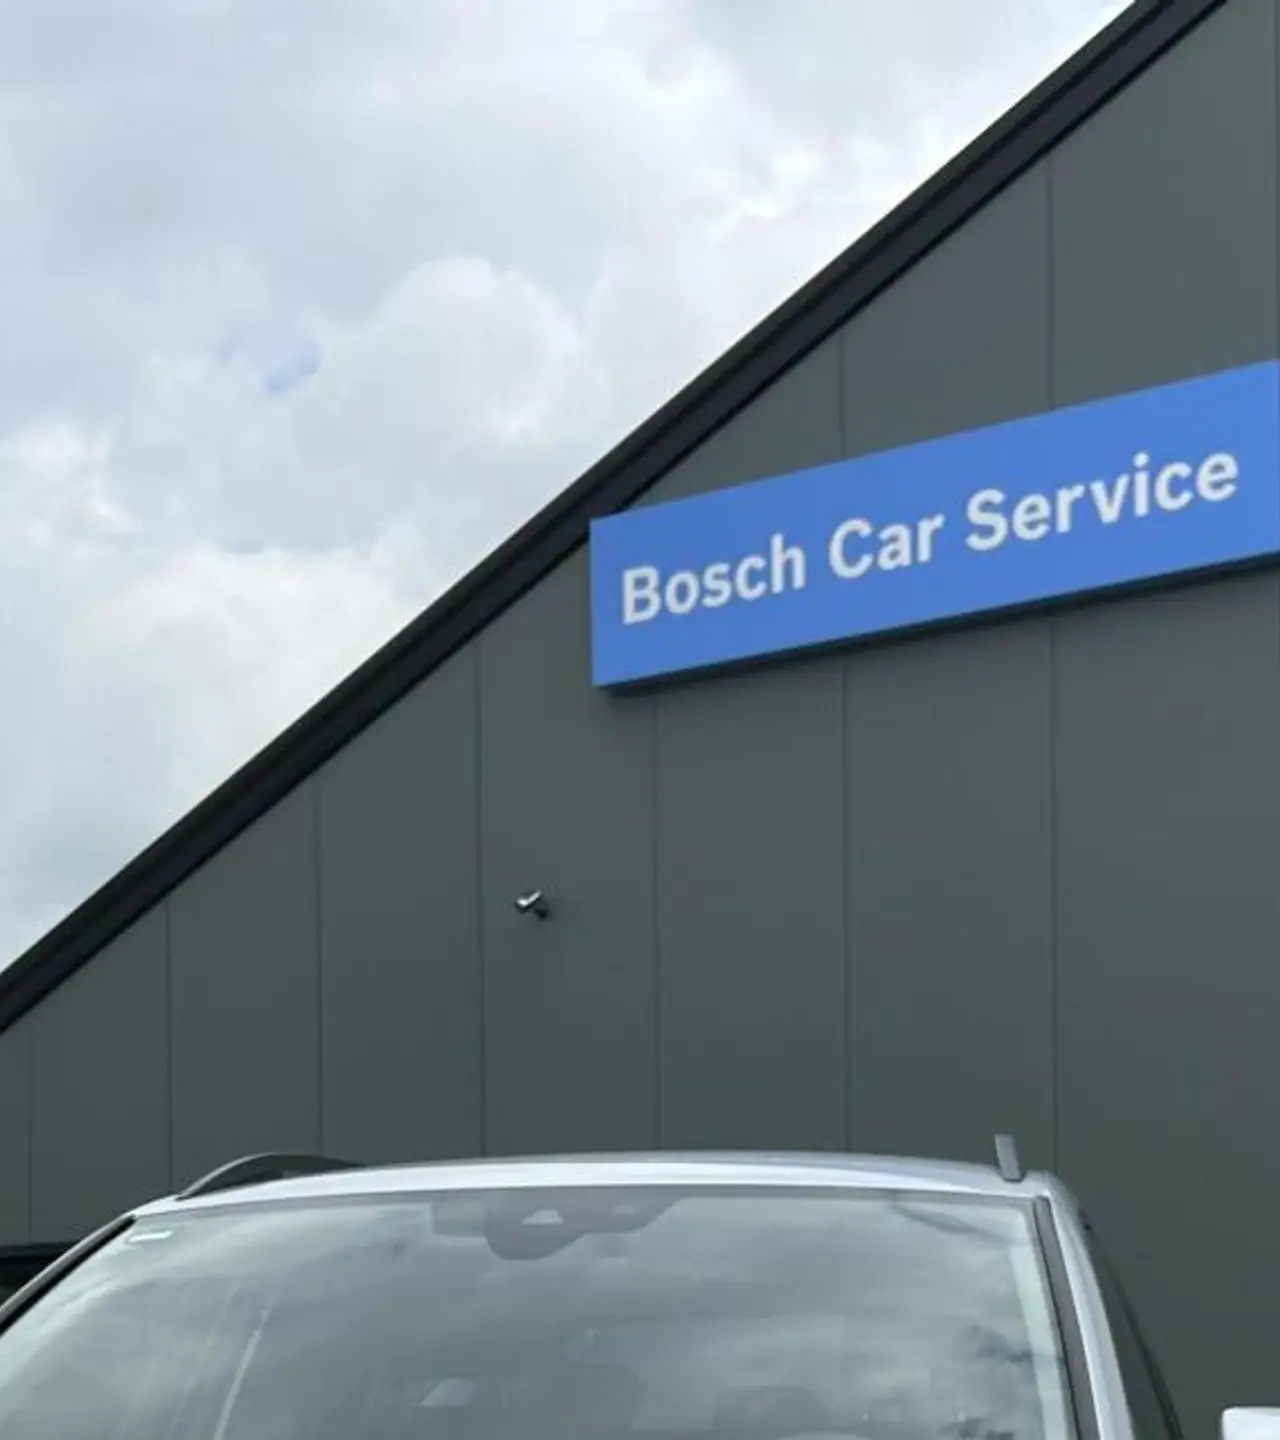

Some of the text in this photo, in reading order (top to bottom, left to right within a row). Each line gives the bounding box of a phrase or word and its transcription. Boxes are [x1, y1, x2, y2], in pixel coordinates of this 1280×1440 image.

[622, 451, 1238, 625] Bosch Car Service
